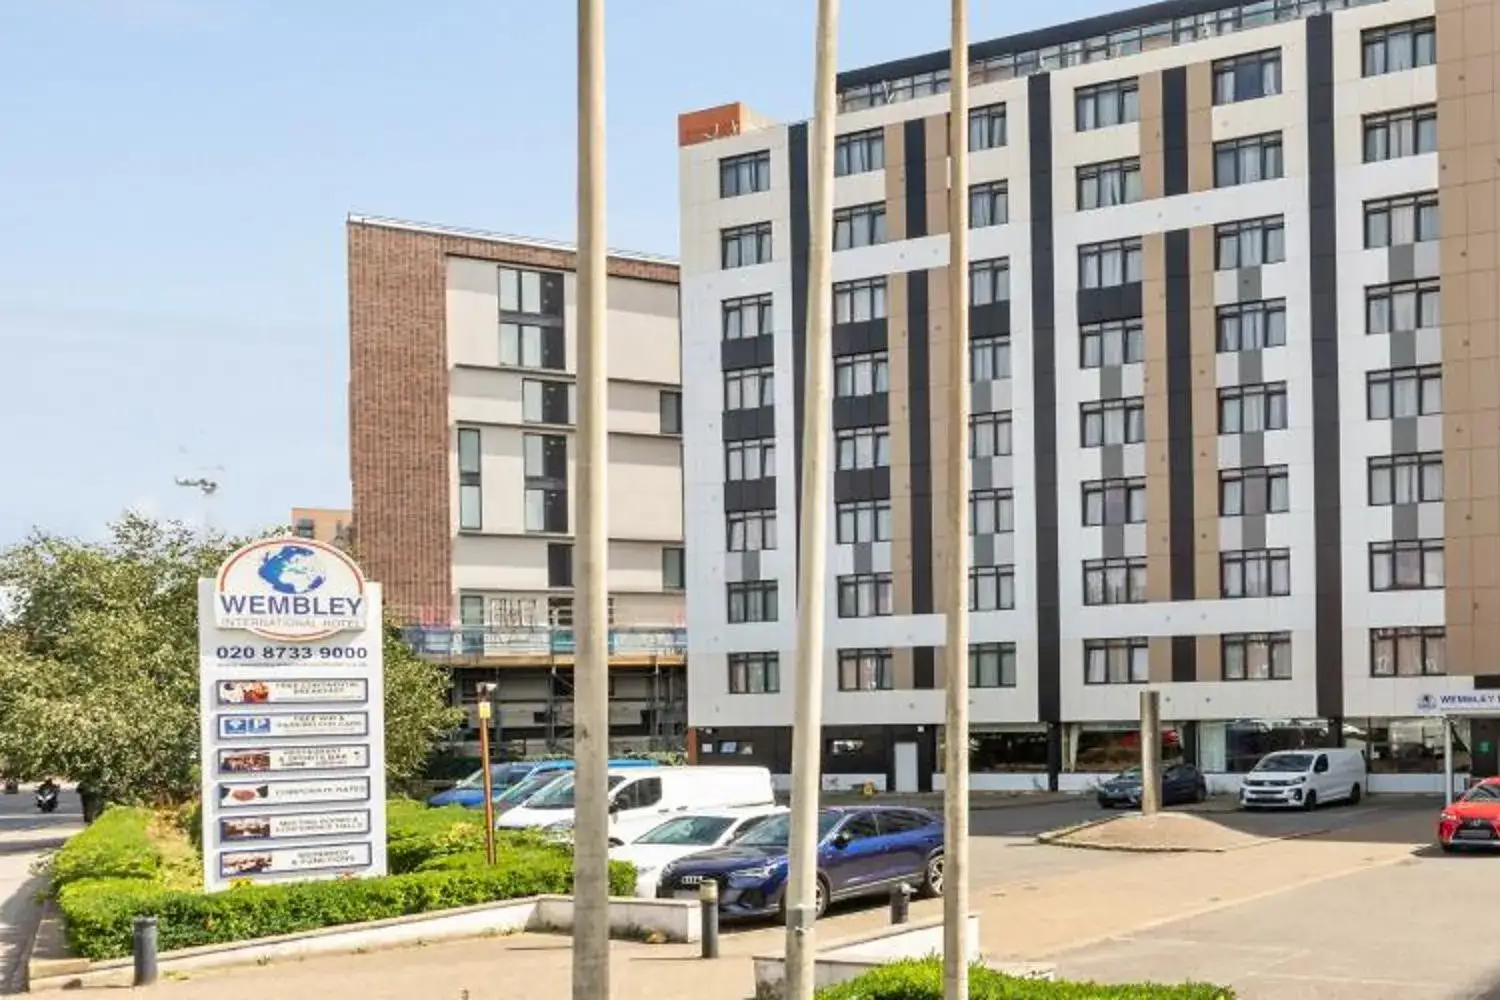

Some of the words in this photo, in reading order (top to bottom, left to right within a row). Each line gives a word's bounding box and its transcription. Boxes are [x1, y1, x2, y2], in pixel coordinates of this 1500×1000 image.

[220, 595, 362, 615] WEMBLEY
[216, 646, 255, 659] 020
[262, 646, 313, 659] 8733
[319, 646, 368, 659] 9000
[1439, 694, 1495, 703] WEMBLEY
